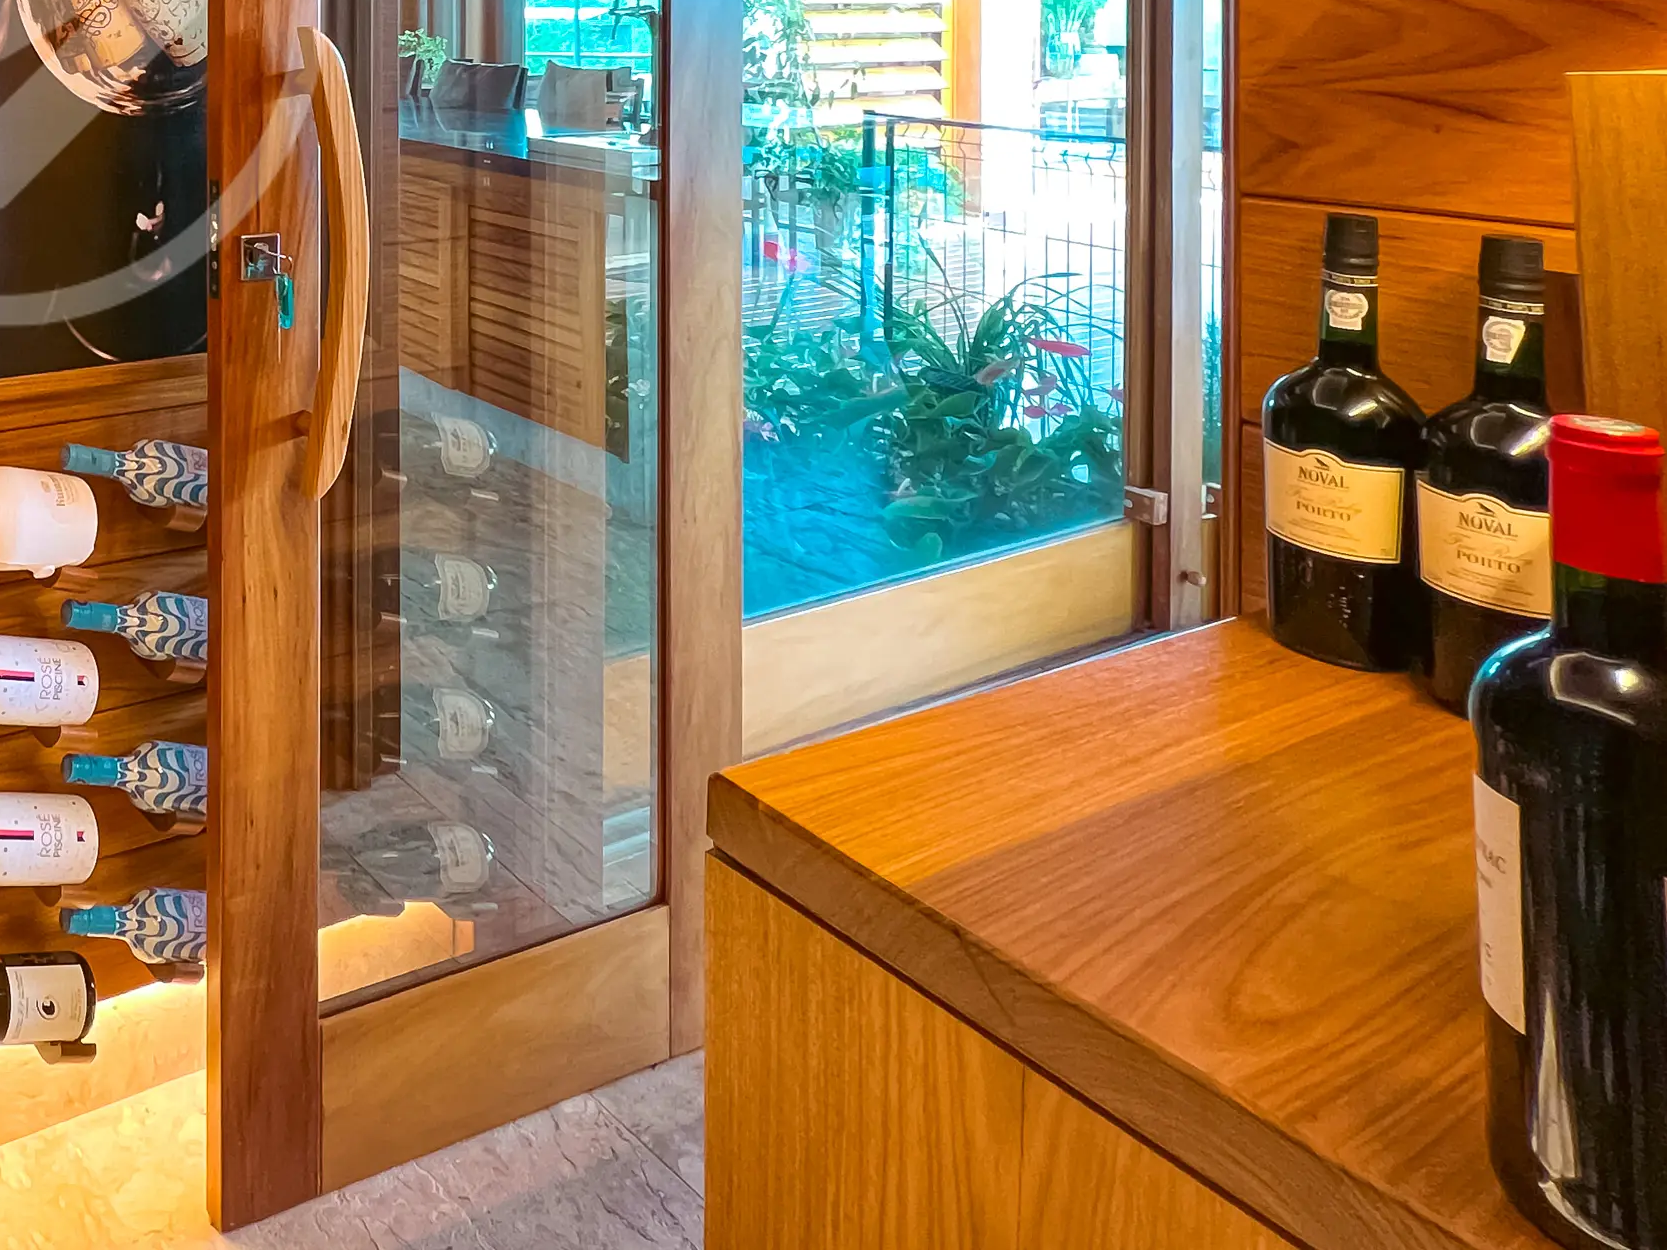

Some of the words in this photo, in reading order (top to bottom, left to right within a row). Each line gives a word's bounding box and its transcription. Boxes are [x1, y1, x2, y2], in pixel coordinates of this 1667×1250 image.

[1297, 466, 1350, 489] NOVAL
[1296, 500, 1352, 522] PORTO
[1458, 511, 1519, 538] NOVAL
[1456, 550, 1521, 574] PORTO
[37, 657, 53, 700] ROSÉ
[52, 657, 63, 700] PISCINE
[36, 813, 53, 857] ROSÉ
[52, 813, 63, 857] PISCINE
